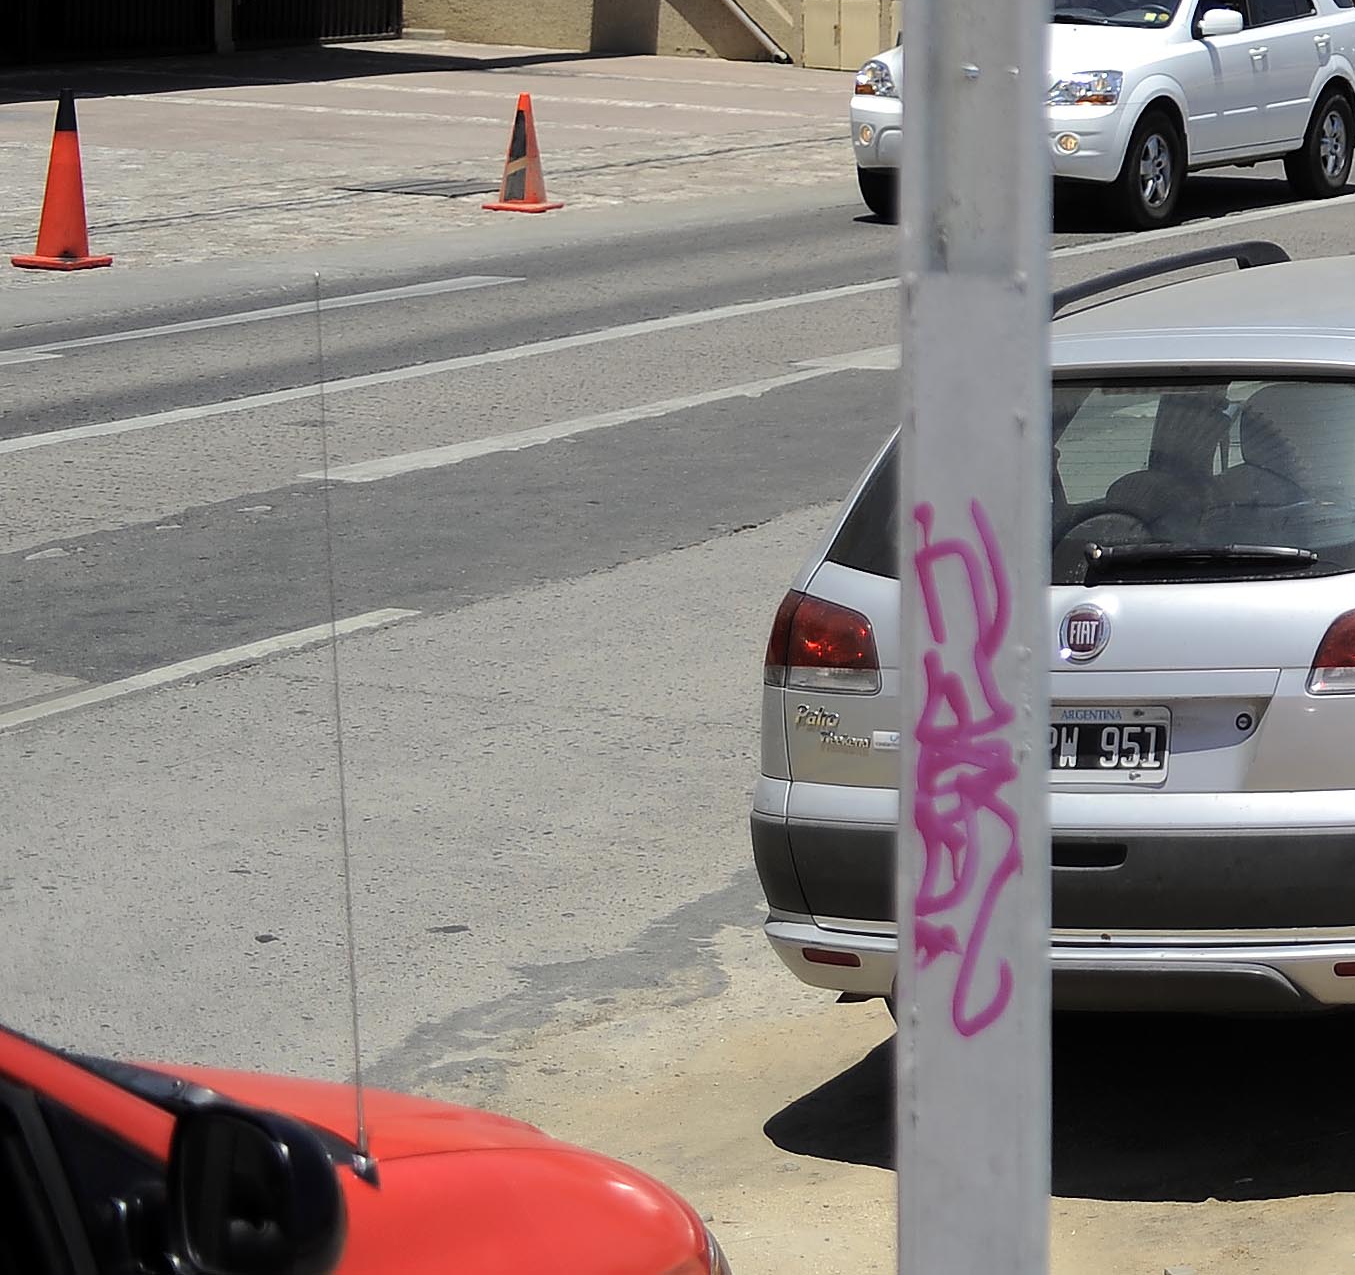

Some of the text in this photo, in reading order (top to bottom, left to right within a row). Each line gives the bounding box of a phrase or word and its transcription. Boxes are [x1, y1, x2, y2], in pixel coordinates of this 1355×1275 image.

[1069, 621, 1099, 645] FIAT
[796, 704, 839, 728] Palio
[1060, 709, 1122, 721] ARGENTINA
[1099, 726, 1160, 767] 951
